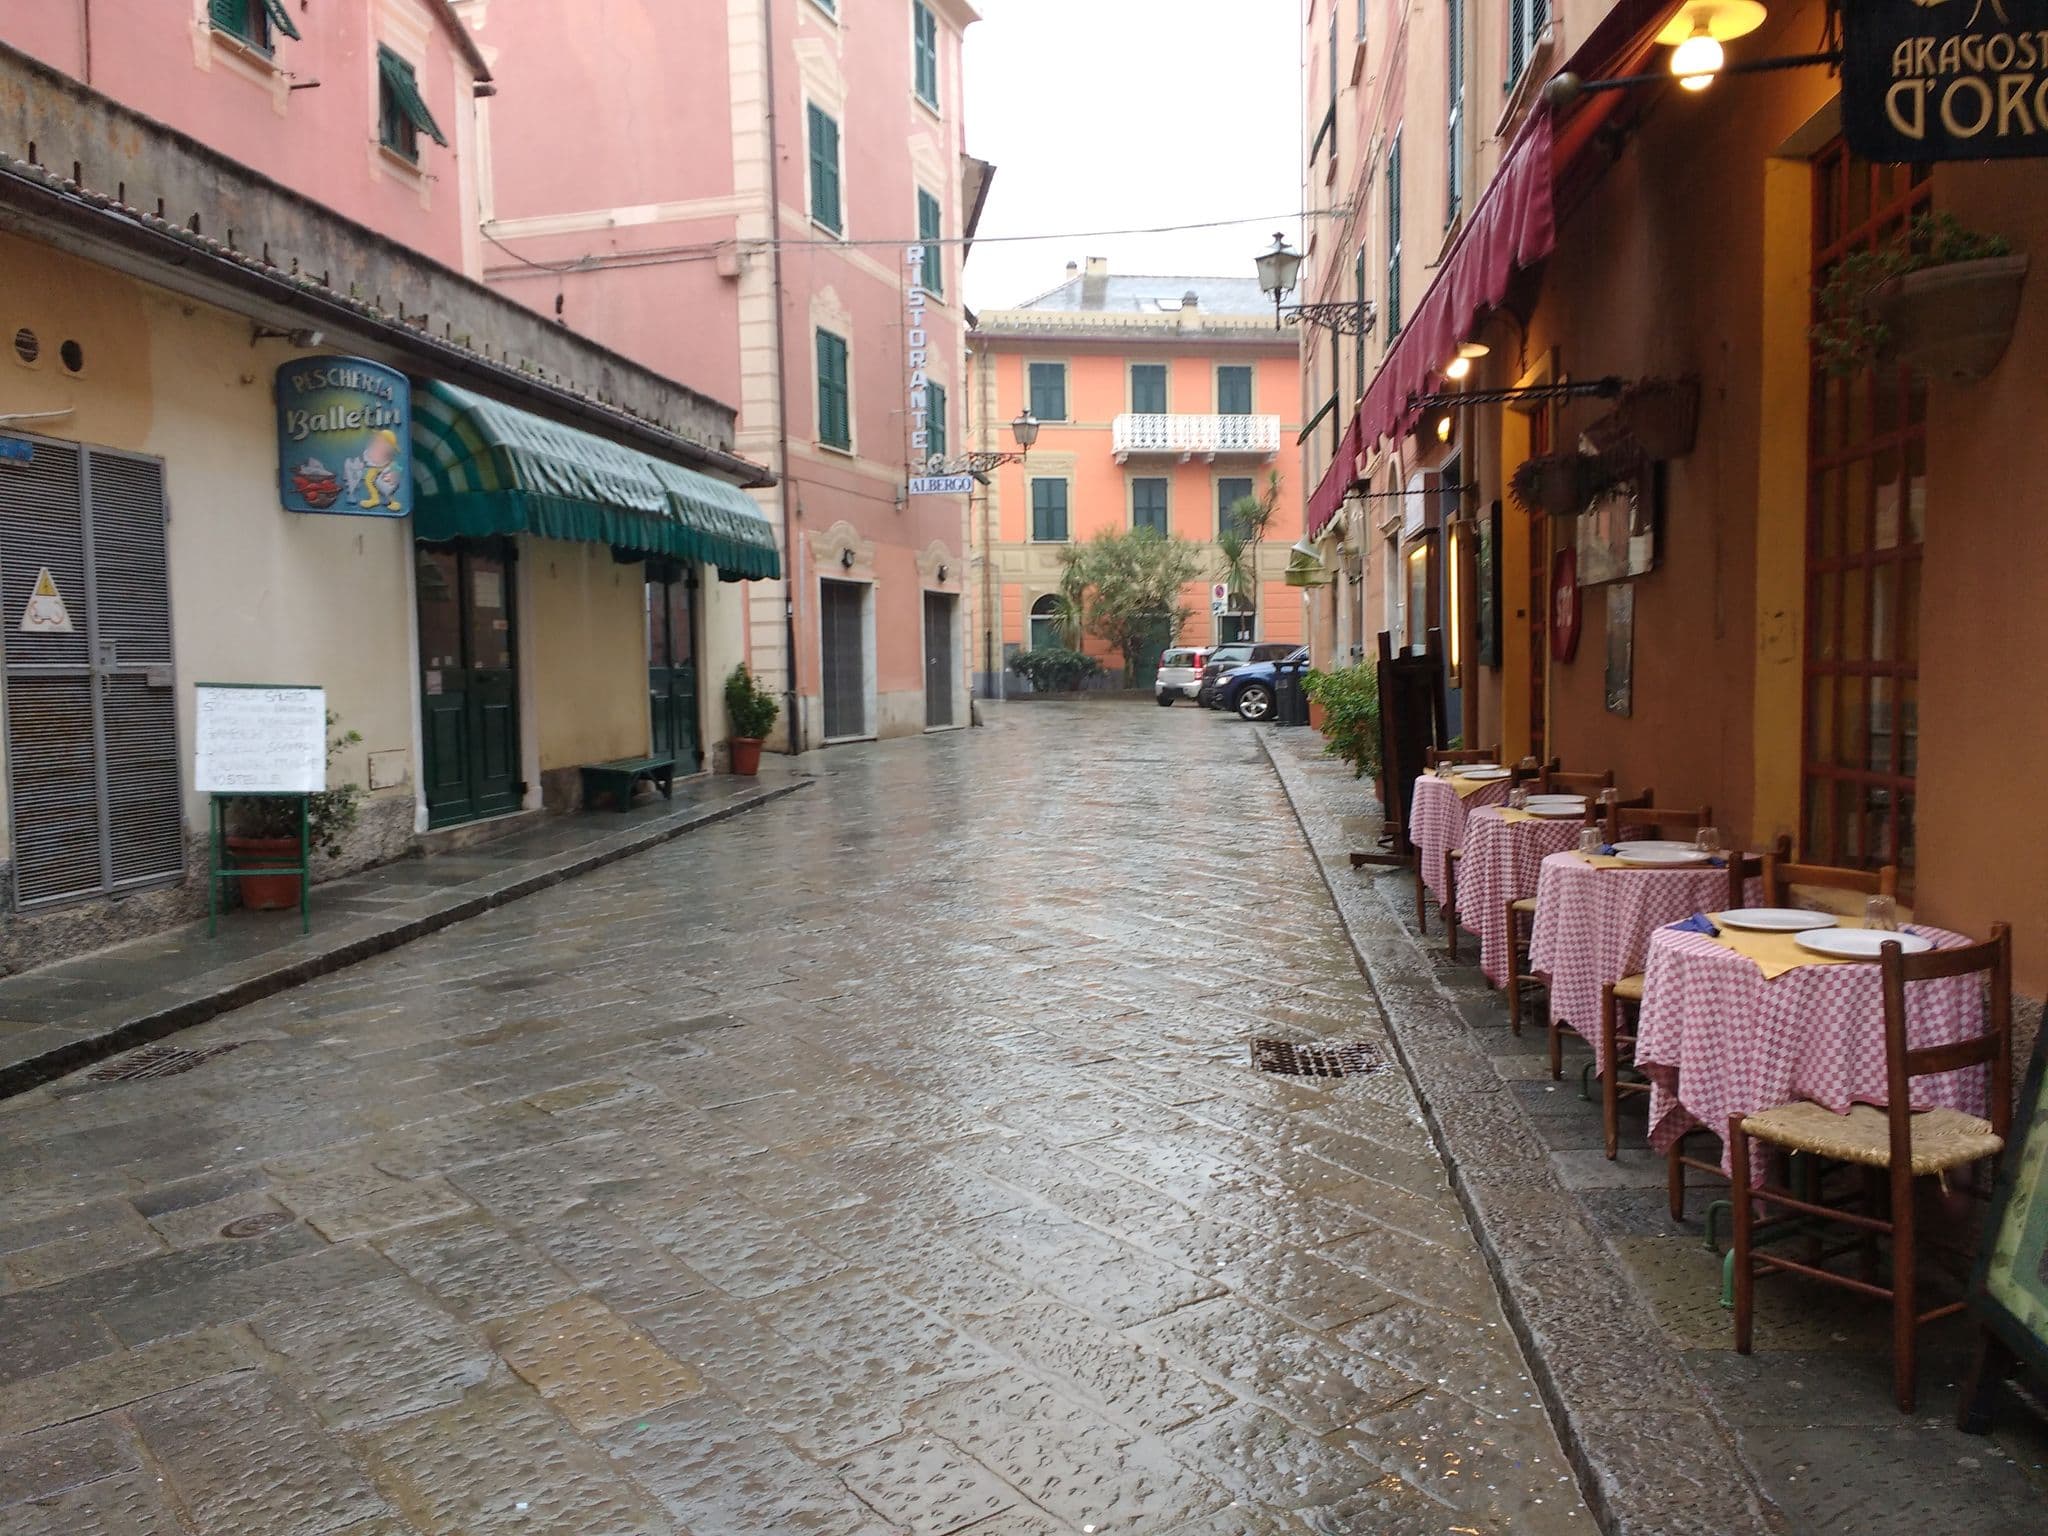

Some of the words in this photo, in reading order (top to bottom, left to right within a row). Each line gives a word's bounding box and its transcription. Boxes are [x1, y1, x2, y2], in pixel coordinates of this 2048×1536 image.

[1885, 73, 2048, 140] D'OR
[907, 245, 928, 448] RISTORANTE
[291, 367, 393, 401] PESCHERIA
[286, 401, 401, 440] Balletin
[911, 477, 971, 492] ALBERGO
